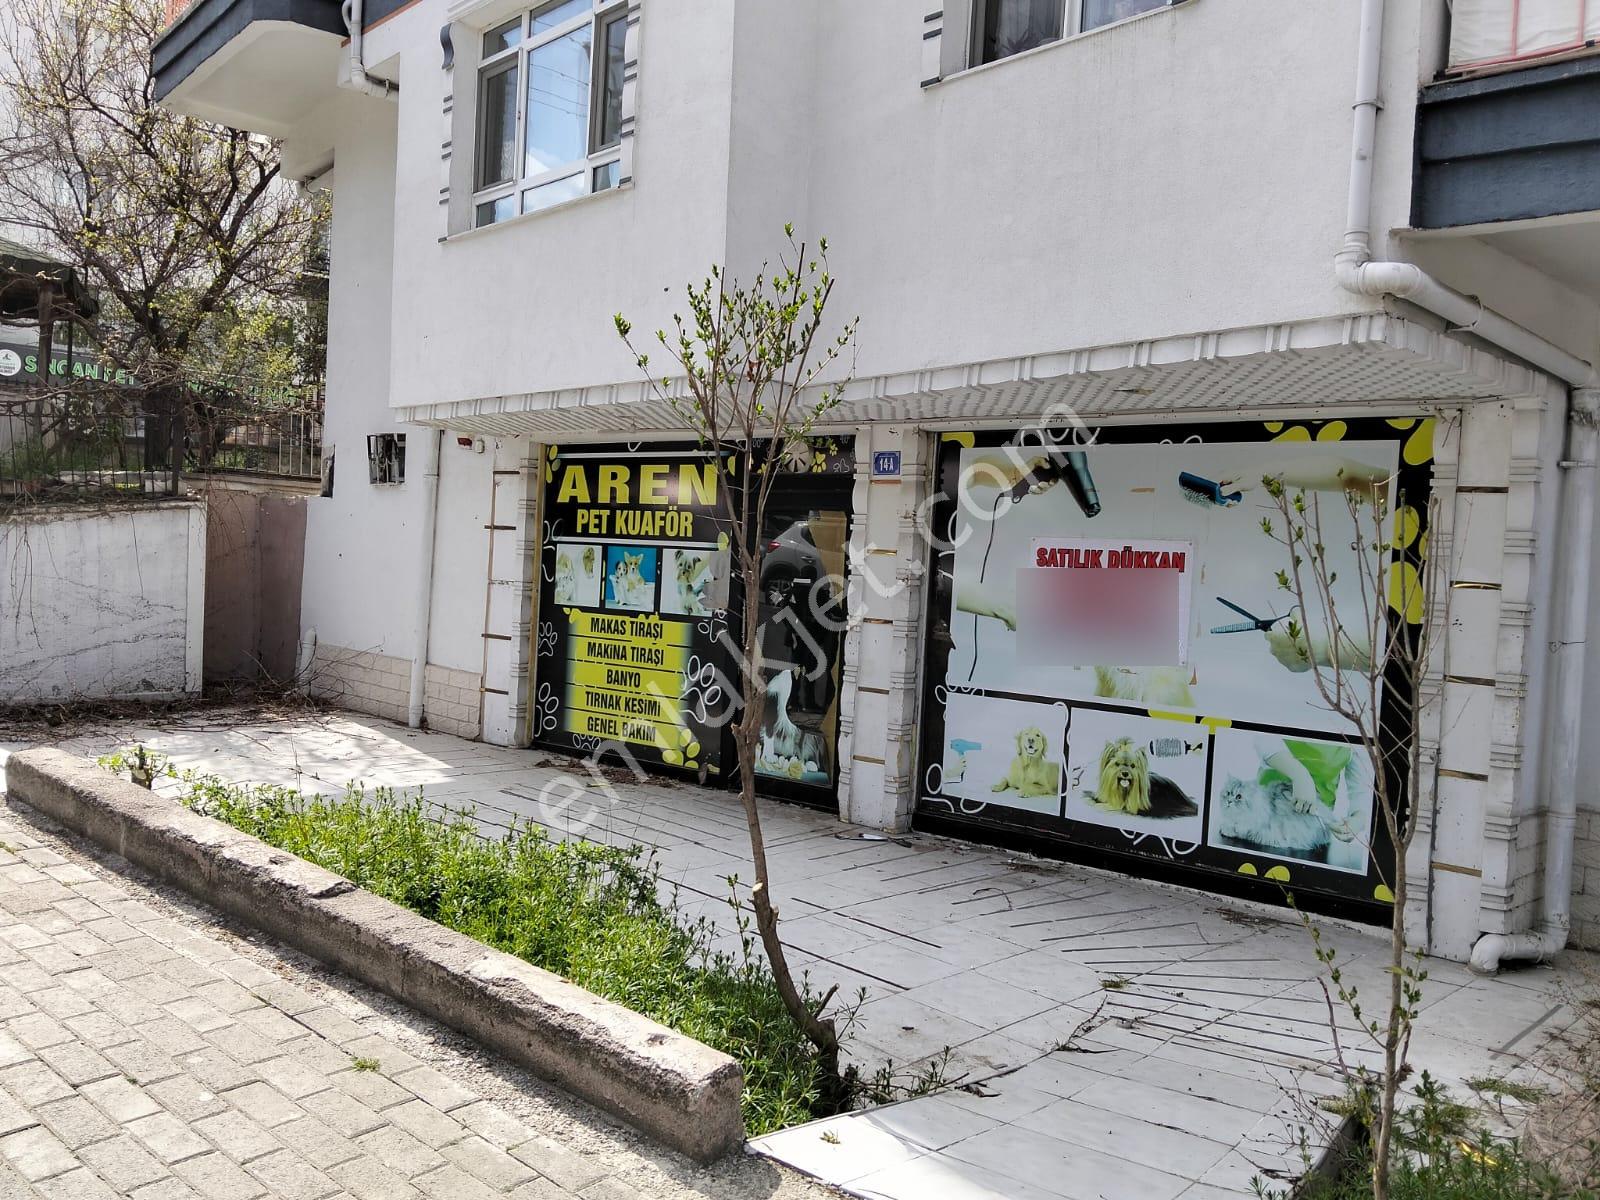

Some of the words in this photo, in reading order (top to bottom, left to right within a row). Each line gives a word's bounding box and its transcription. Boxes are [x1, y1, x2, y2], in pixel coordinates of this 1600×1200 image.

[25, 355, 98, 379] SNCAN
[556, 464, 718, 506] AREN
[576, 509, 610, 534] PET
[615, 506, 693, 537] KUAFÖR
[1036, 548, 1104, 568] SATILIK
[1107, 546, 1186, 573] DÜKKAN
[590, 617, 627, 636] MAKAS
[629, 620, 663, 641] TIRAŞI
[630, 646, 664, 666] TIRAŞI
[606, 669, 641, 688] BANYO
[585, 691, 621, 711] TIRNAK
[587, 716, 619, 736] GENEL
[622, 721, 657, 743] BAKIM
